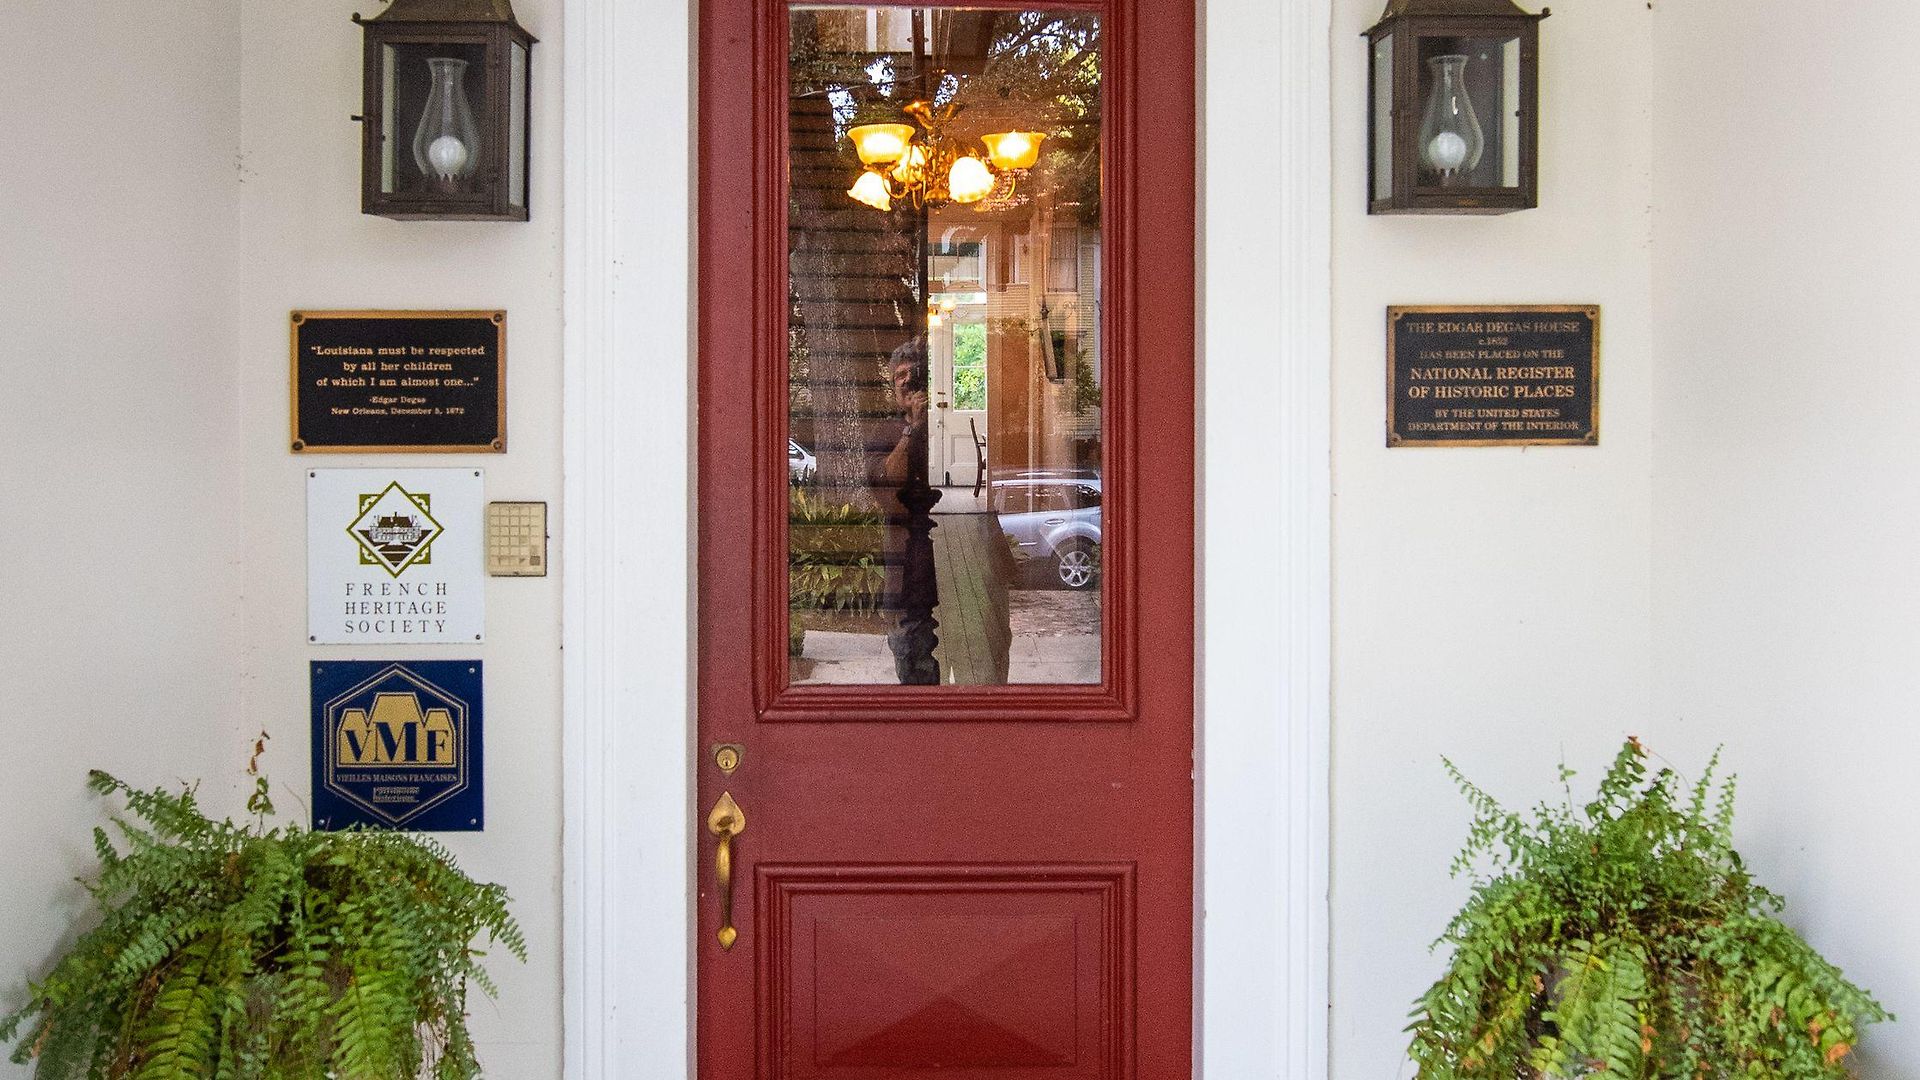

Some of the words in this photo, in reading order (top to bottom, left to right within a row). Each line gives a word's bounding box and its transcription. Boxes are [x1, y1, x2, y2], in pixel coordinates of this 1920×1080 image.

[1407, 323, 1435, 333] THE
[1438, 323, 1482, 333] EDGAR
[1487, 322, 1530, 333] DEGAS
[1534, 322, 1580, 333] HOUSE
[378, 347, 406, 355] must
[411, 346, 424, 355] be
[429, 346, 485, 357] respected
[1419, 350, 1443, 359] HAS
[1446, 351, 1474, 359] BEEN
[1478, 350, 1520, 359] PLACED
[1523, 350, 1539, 359] ON
[1540, 350, 1564, 359] THE
[343, 363, 357, 373] by
[361, 363, 376, 371] all
[381, 363, 400, 371] her
[404, 362, 452, 371] children
[1411, 367, 1492, 380] NATIONAL
[1497, 366, 1575, 379] REGISTER
[316, 378, 328, 387] of
[332, 377, 366, 387] which
[370, 378, 376, 386] I
[380, 379, 397, 387] am
[401, 378, 440, 387] almost
[1408, 386, 1430, 398] OF
[1435, 386, 1510, 398] HISTORIC
[1513, 385, 1575, 398] PLACES
[400, 396, 426, 404] Degas
[1435, 409, 1448, 418] BY
[1452, 409, 1475, 418] THE
[1478, 409, 1520, 418] UNITED
[1522, 409, 1560, 418] STATES
[1408, 422, 1482, 431] DEPARTMENT
[1484, 422, 1498, 431] OF
[1501, 422, 1524, 431] THE
[1527, 422, 1579, 431] INTERIOR
[346, 583, 447, 596] FRENCH
[345, 602, 447, 615] HERITAGE
[345, 620, 446, 633] SOCIETY
[344, 722, 449, 762] VMF
